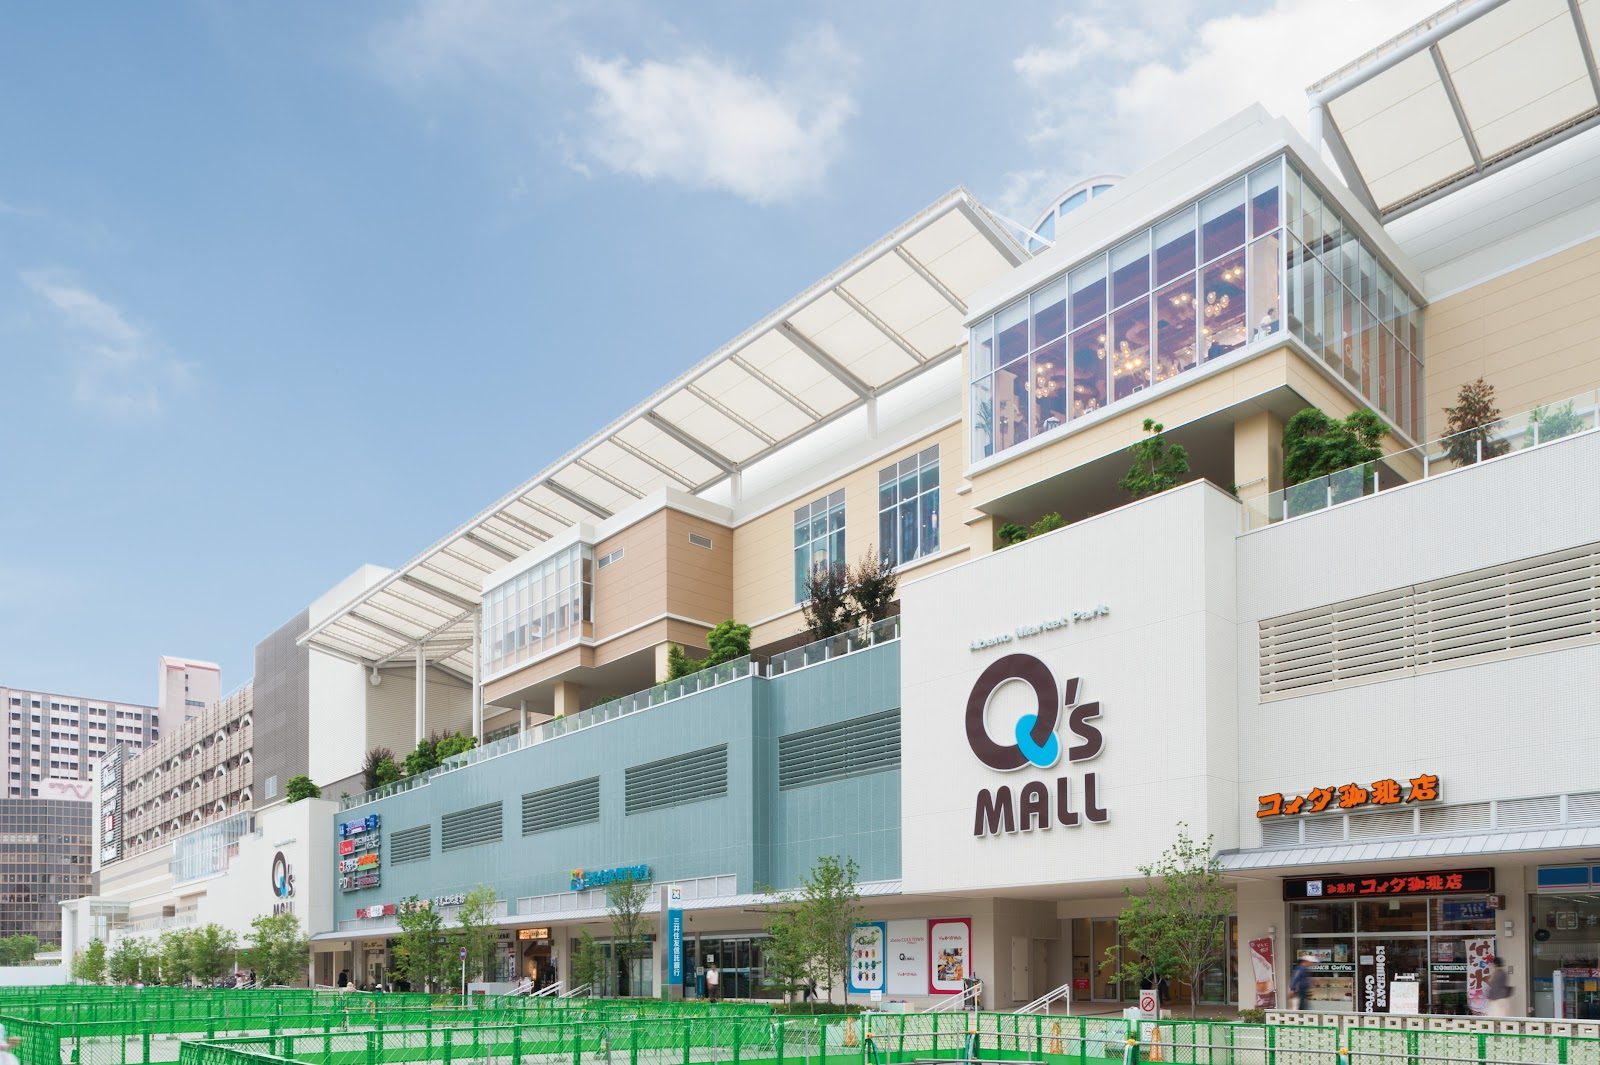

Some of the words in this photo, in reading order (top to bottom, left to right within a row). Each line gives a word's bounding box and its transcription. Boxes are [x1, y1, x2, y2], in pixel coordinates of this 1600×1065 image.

[1071, 604, 1110, 624] Park
[965, 652, 1106, 773] Q's
[974, 772, 1111, 838] MALL
[1257, 773, 1440, 818] コメダ珈琲店
[272, 850, 296, 899] Q's
[1359, 874, 1463, 894] コメダ珈琲店
[1365, 974, 1376, 1013] Coffee
[1375, 945, 1387, 1007] KOMEDA'S
